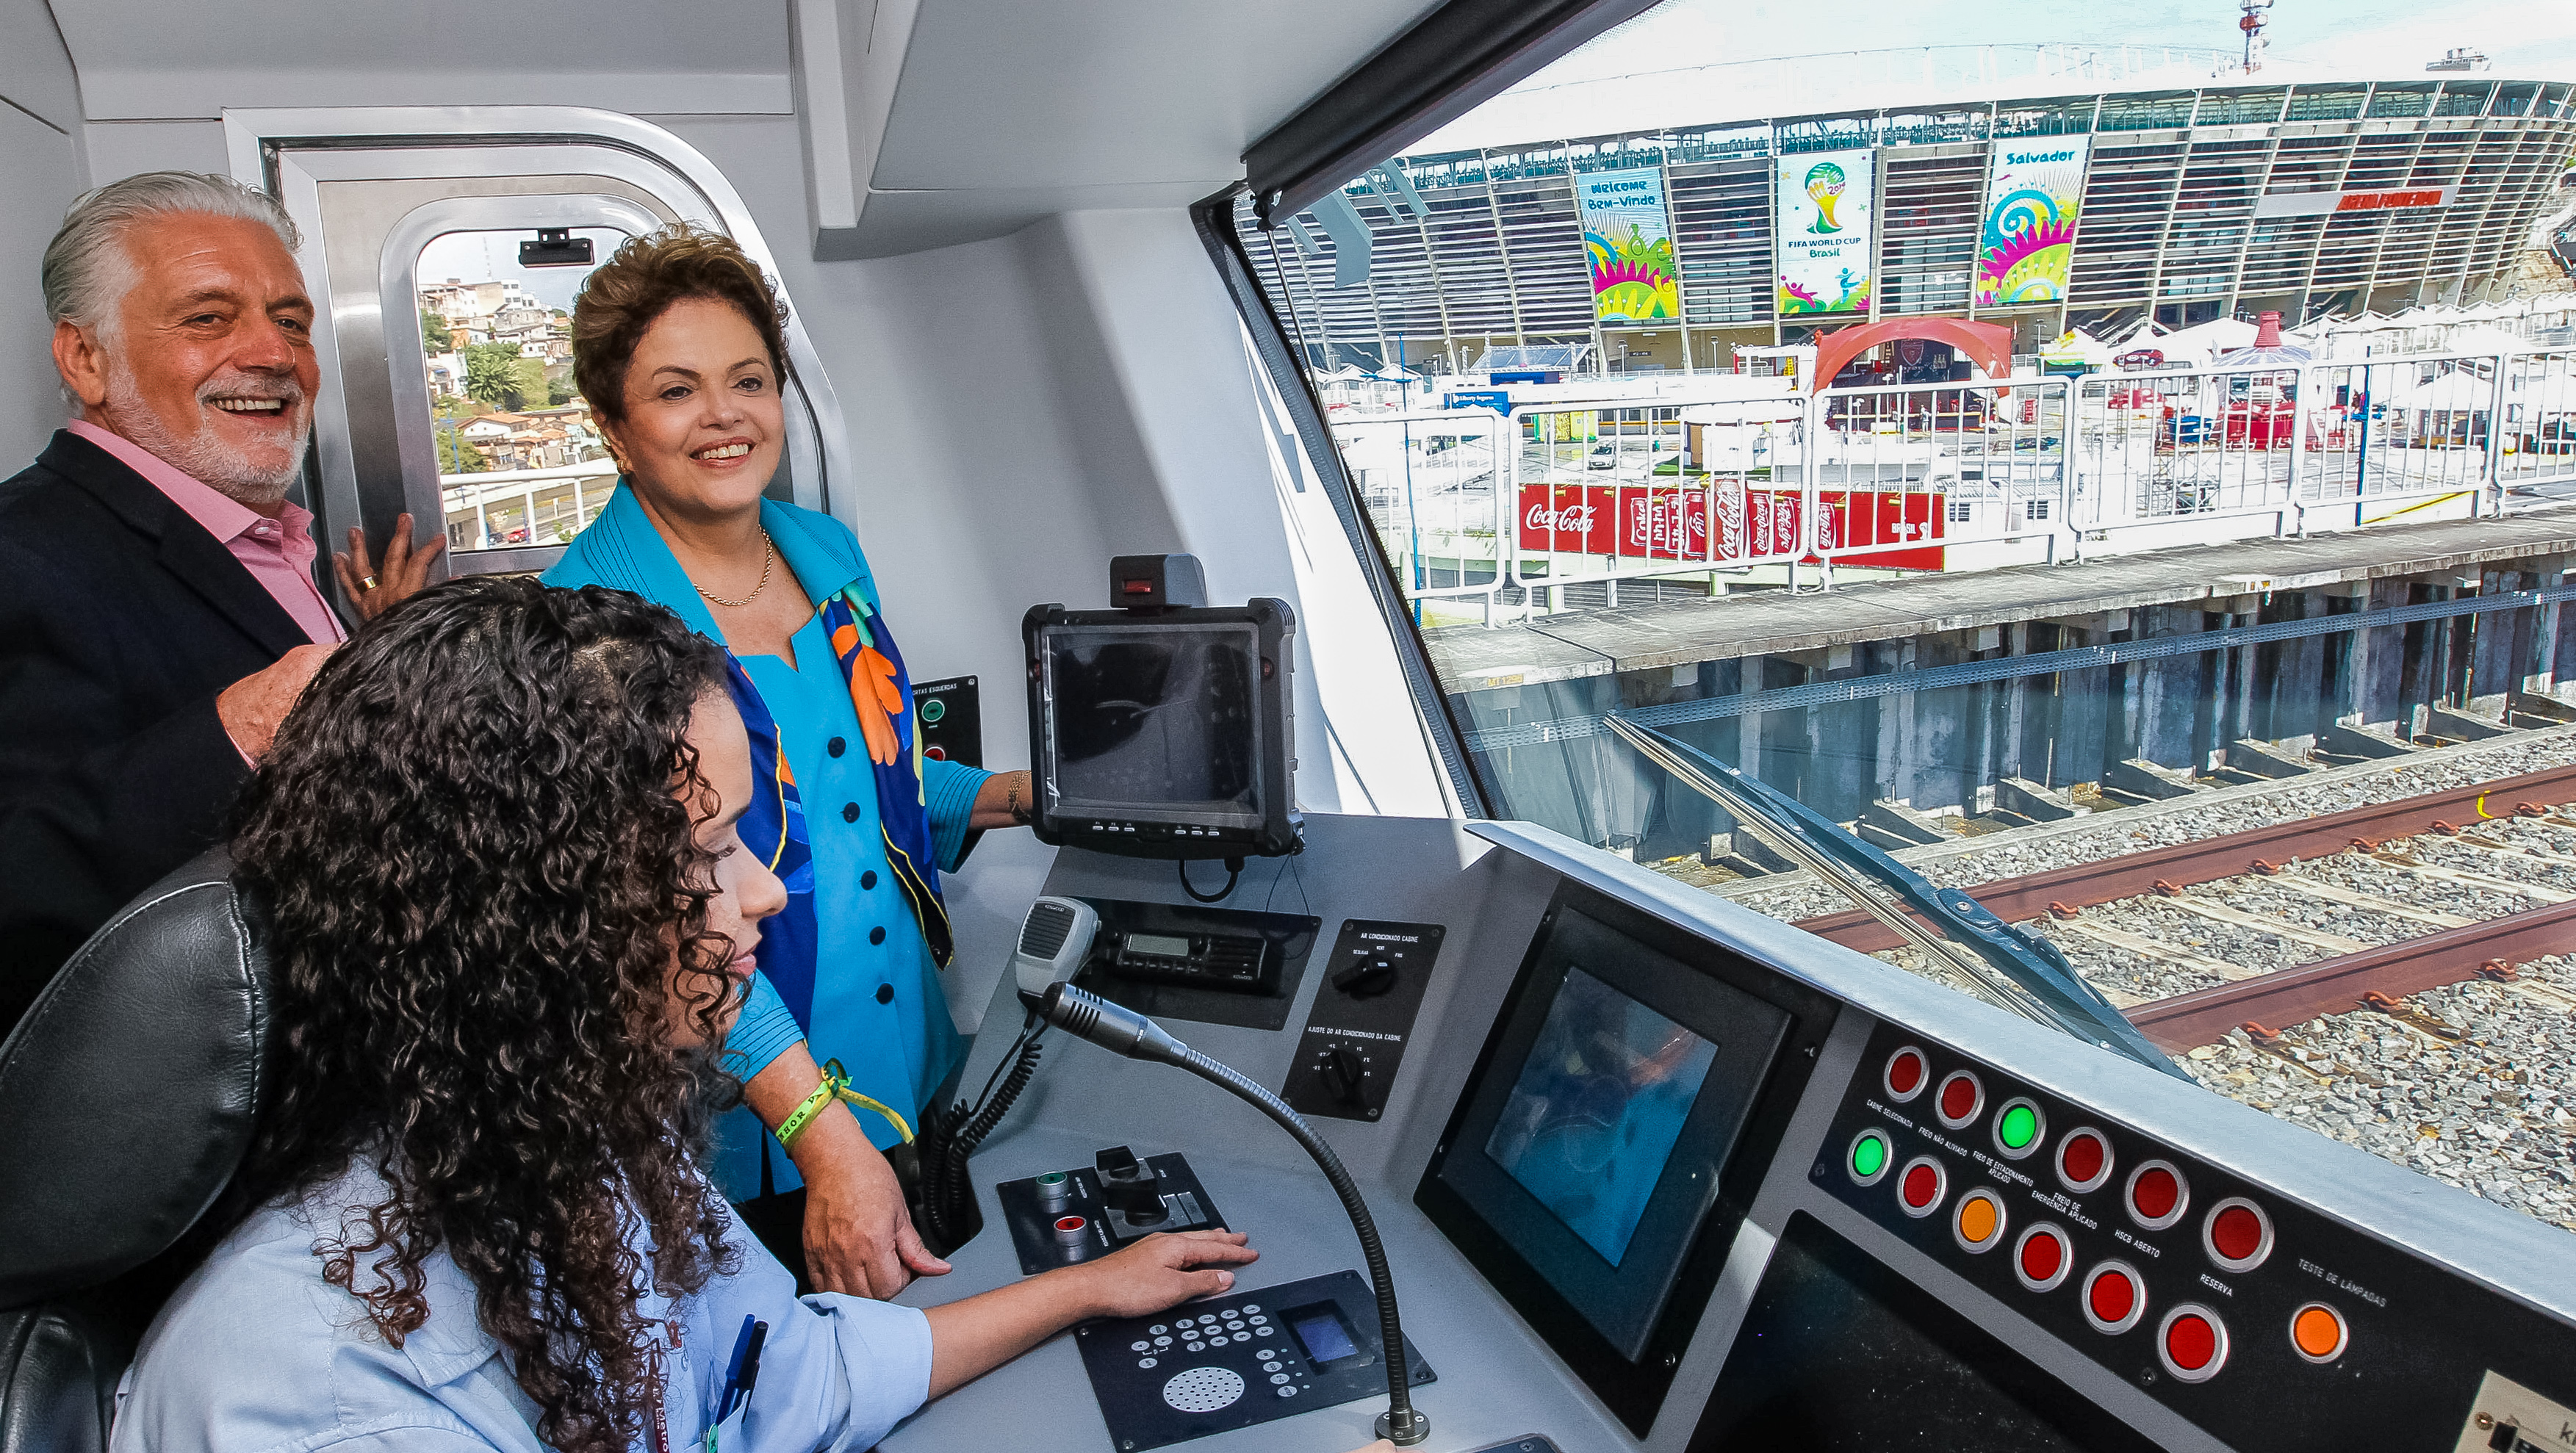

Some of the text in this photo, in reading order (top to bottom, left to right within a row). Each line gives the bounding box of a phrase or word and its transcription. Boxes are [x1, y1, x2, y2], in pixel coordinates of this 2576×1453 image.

[2007, 151, 2075, 165] Salvador
[1591, 181, 1647, 194] Welcome
[1827, 181, 1846, 195] 2014
[1588, 195, 1655, 210] Bem-Vindo
[1809, 238, 1842, 246] WORLD
[1810, 248, 1841, 258] Brasil
[1891, 522, 1915, 534] BRSIL
[1342, 1029, 1375, 1039] CONDICIONADO
[1384, 1034, 1401, 1042] CABINE
[1866, 1099, 1913, 1128] CABINE SELECIONADA
[1918, 1126, 1968, 1157] FREIO NÃO ALIVIADO
[1972, 1150, 2034, 1187] FREIO DE ESTACIONAMENTO
[1988, 1168, 2011, 1184] APLICADO
[2052, 1192, 2082, 1212] FREIO DE
[2068, 1211, 2098, 1230] APLICADO
[2115, 1229, 2160, 1258] HSCB ABERTO
[2298, 1258, 2324, 1277] TESTE
[2325, 1272, 2339, 1285] DE
[2200, 1274, 2233, 1297] RESERVA
